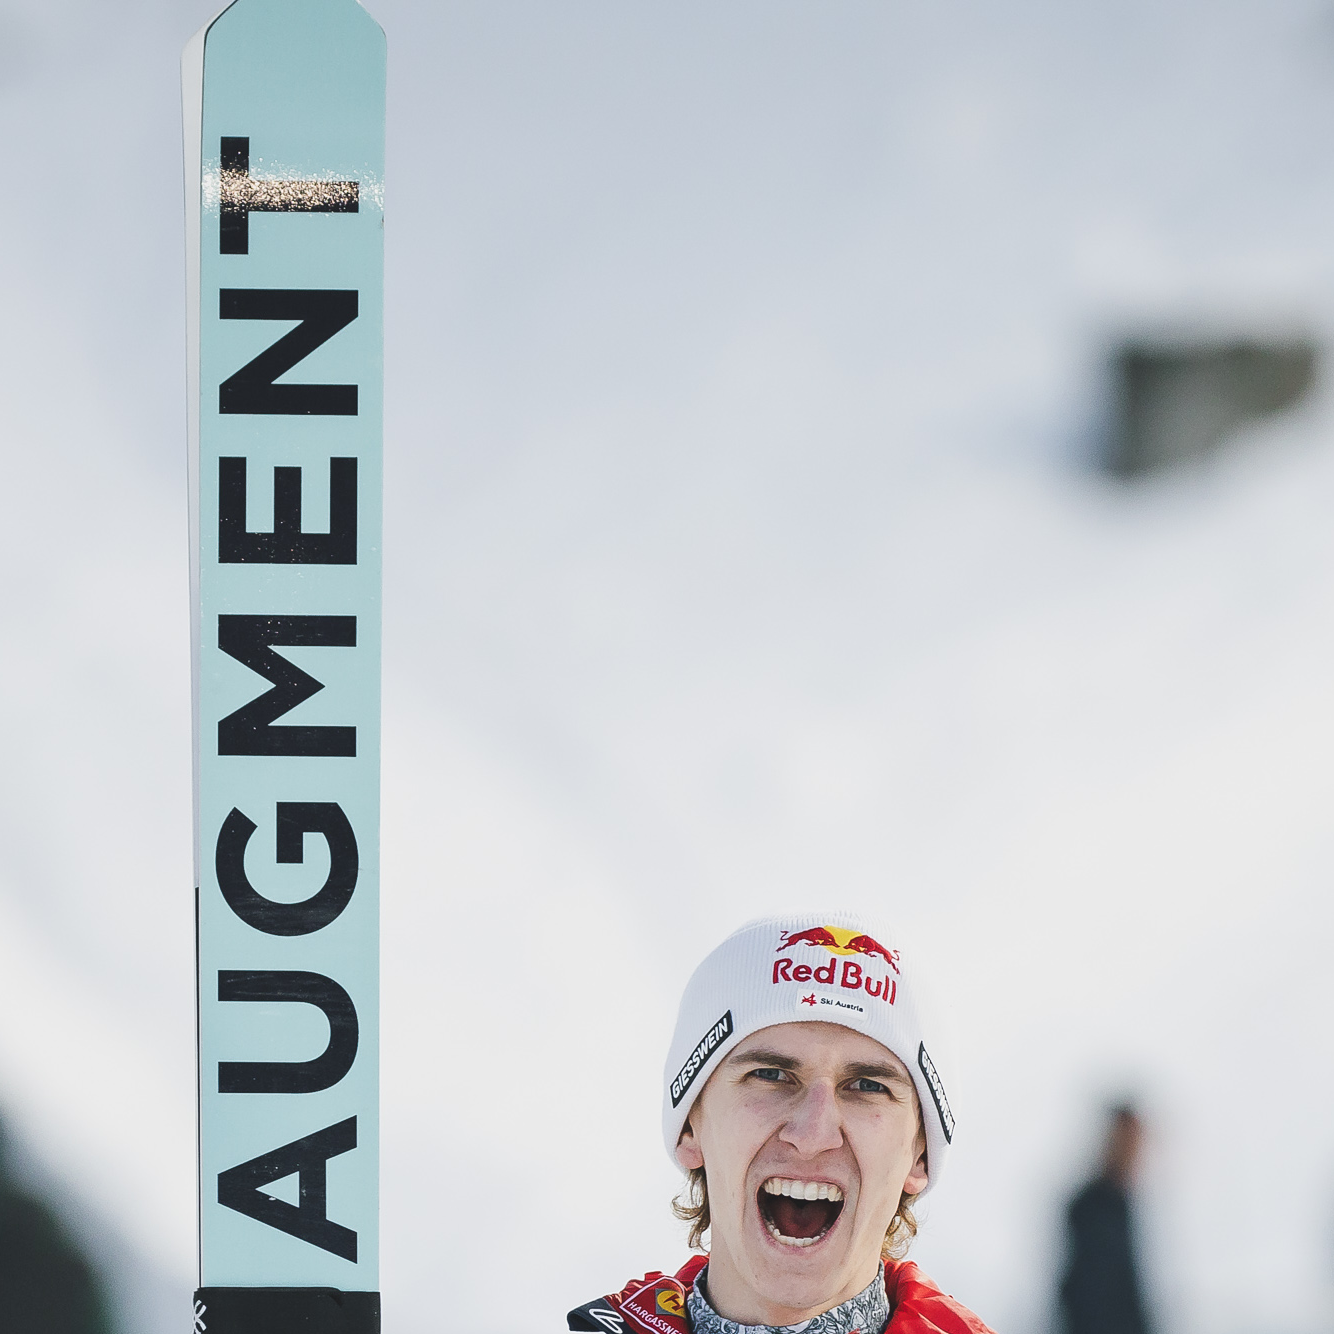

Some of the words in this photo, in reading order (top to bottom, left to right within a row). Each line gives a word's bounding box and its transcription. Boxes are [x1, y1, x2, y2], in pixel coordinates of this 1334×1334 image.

[215, 137, 359, 1264] AUGMENT
[772, 957, 837, 985] Red
[840, 961, 897, 1006] Bull
[820, 997, 833, 1006] Ski
[834, 999, 864, 1013] Austria
[671, 1017, 729, 1099] GIESSWEIN
